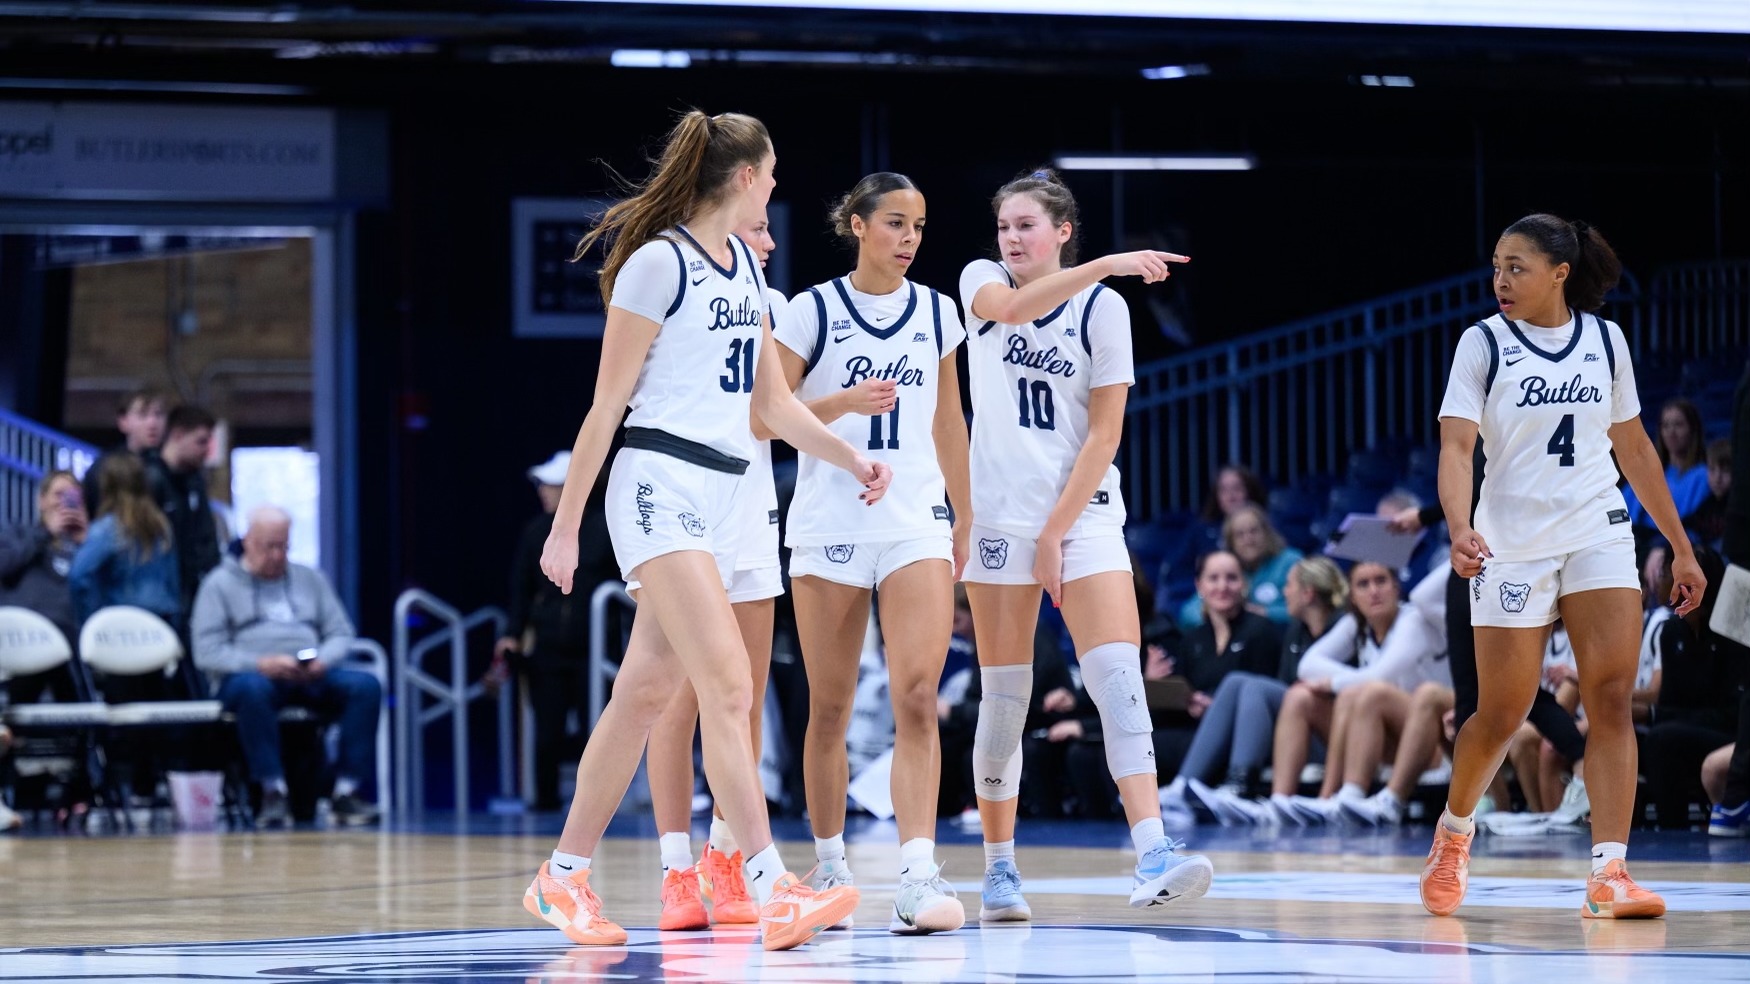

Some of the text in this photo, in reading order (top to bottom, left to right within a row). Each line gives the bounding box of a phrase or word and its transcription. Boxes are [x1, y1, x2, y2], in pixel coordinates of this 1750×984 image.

[719, 337, 755, 393] 31
[1003, 333, 1076, 378] Butler
[1018, 376, 1056, 431] 10
[1516, 373, 1603, 408] Butler
[867, 396, 900, 450] 11
[1546, 413, 1575, 467] 4
